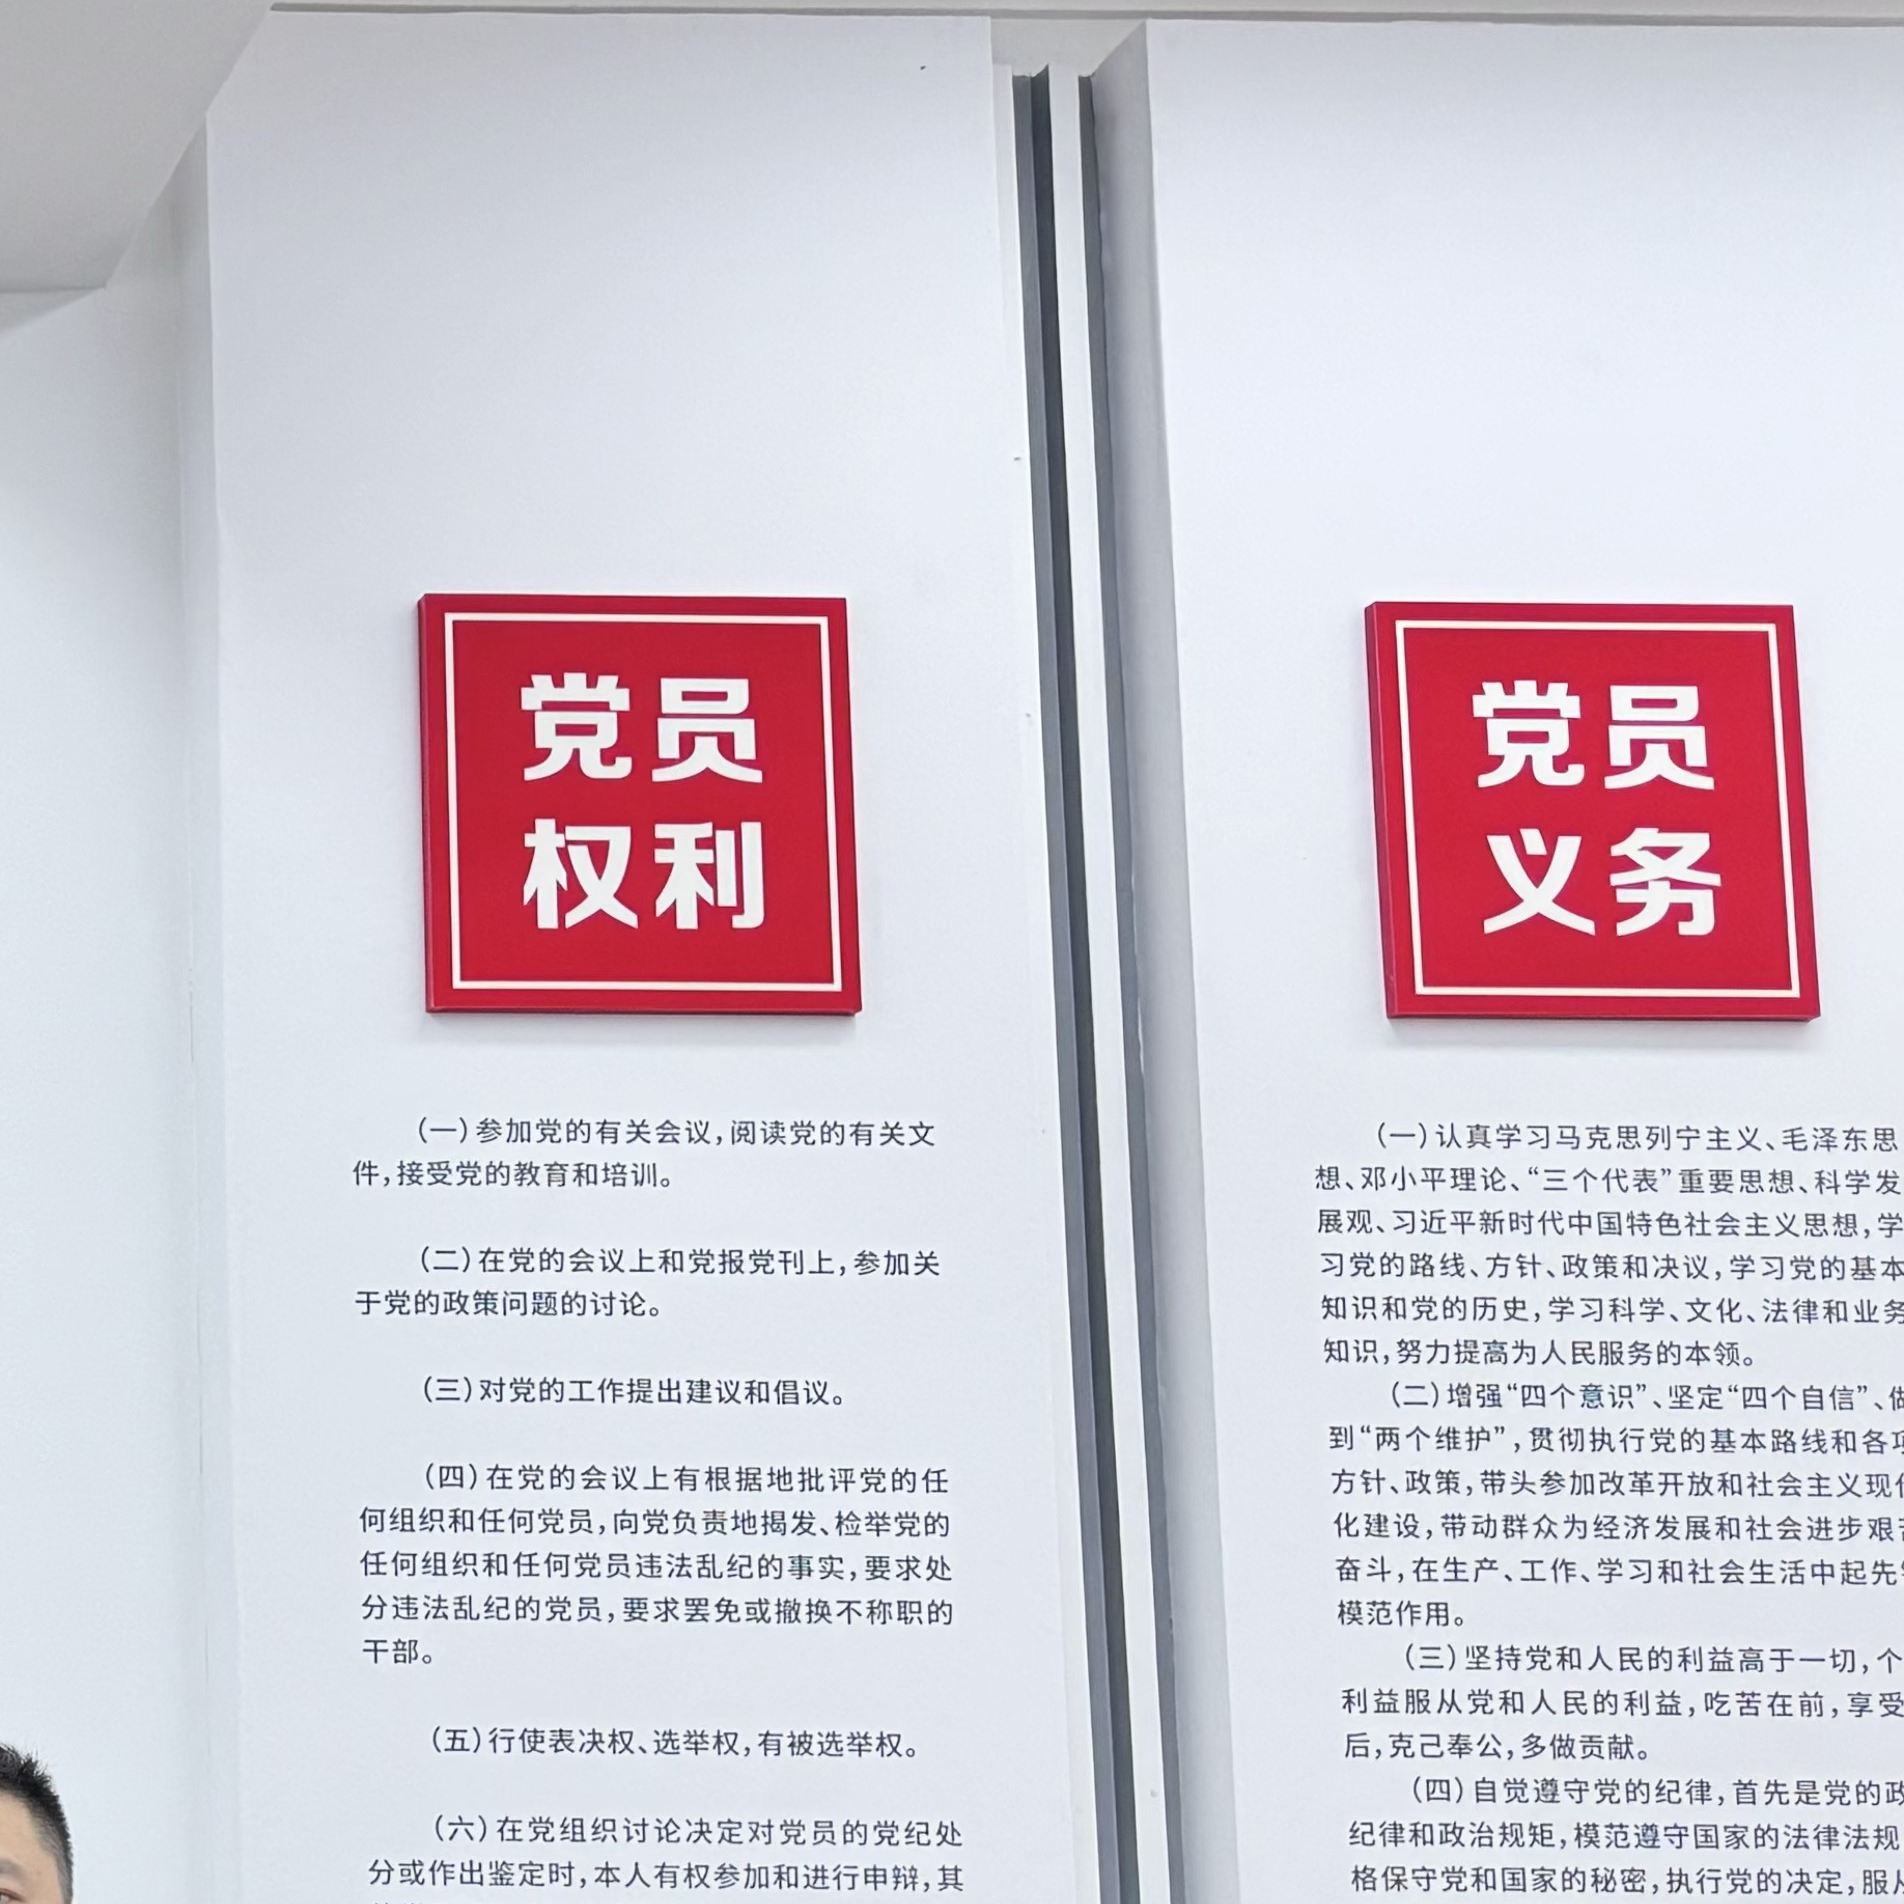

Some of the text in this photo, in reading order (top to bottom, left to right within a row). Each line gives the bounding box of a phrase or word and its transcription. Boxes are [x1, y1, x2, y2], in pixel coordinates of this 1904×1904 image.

[520, 672, 763, 783] 党员
[1472, 680, 1715, 790] 党员
[521, 817, 765, 931] 权利
[1483, 826, 1722, 937] 义务
[419, 1117, 935, 1147] （一）参加党的有关会议，阅读党的有关文
[1378, 1122, 1898, 1152] （一）认真学习马克思列宁主义、毛泽东思
[352, 1160, 670, 1188] 件，接受党的教育和培训。
[1315, 1165, 1901, 1195] 想、邓小平理论、“三个代表”重要思想、科学发
[1318, 1209, 1903, 1239] 展观、习近平新时代中国特色社会主义思想，学
[421, 1246, 940, 1276] （二）在党的会议上和党报党刊上，参加关
[355, 1289, 659, 1317] 于党的政策问题的讨论。
[1324, 1338, 1753, 1367] 知识，努力提高为人民服务的本领。
[424, 1376, 842, 1405] （三）对党的工作提出建议和倡议。
[426, 1462, 948, 1494] （四）在党的会议上有根据地批评党的任
[359, 1506, 949, 1537] 何组织和任何党员，向党负责地揭发、检举党的
[1333, 1512, 1904, 1542] 化建设，带动群众为经济发展和社会进步艰
[360, 1550, 952, 1582] 任何组织和任何党员违法乱纪的事实，要求处
[1335, 1555, 1904, 1586] 奋斗，在生产、工作、学习和社会生活中起先
[361, 1594, 952, 1625] 分违法乱纪的党员，要求罢免或撤换不称职的
[1338, 1599, 1463, 1627] 模范作用。
[362, 1638, 432, 1664] 干部。
[1406, 1643, 1903, 1675] （三）坚持党和人民的利益高于一切，个
[433, 1726, 915, 1758] （五）行使表决权、选举权，有被选举权。
[1345, 1732, 1647, 1760] 后，克己奉公，多做贡献。
[435, 1814, 963, 1847] （六）在党组织讨论决定对党员的党纪处
[1349, 1820, 1900, 1851] 纪律和政治规矩，模范遵守国家的法律法规
[368, 1859, 964, 1893] 分或作出鉴定时，本人有权参加和进行申辩，其
